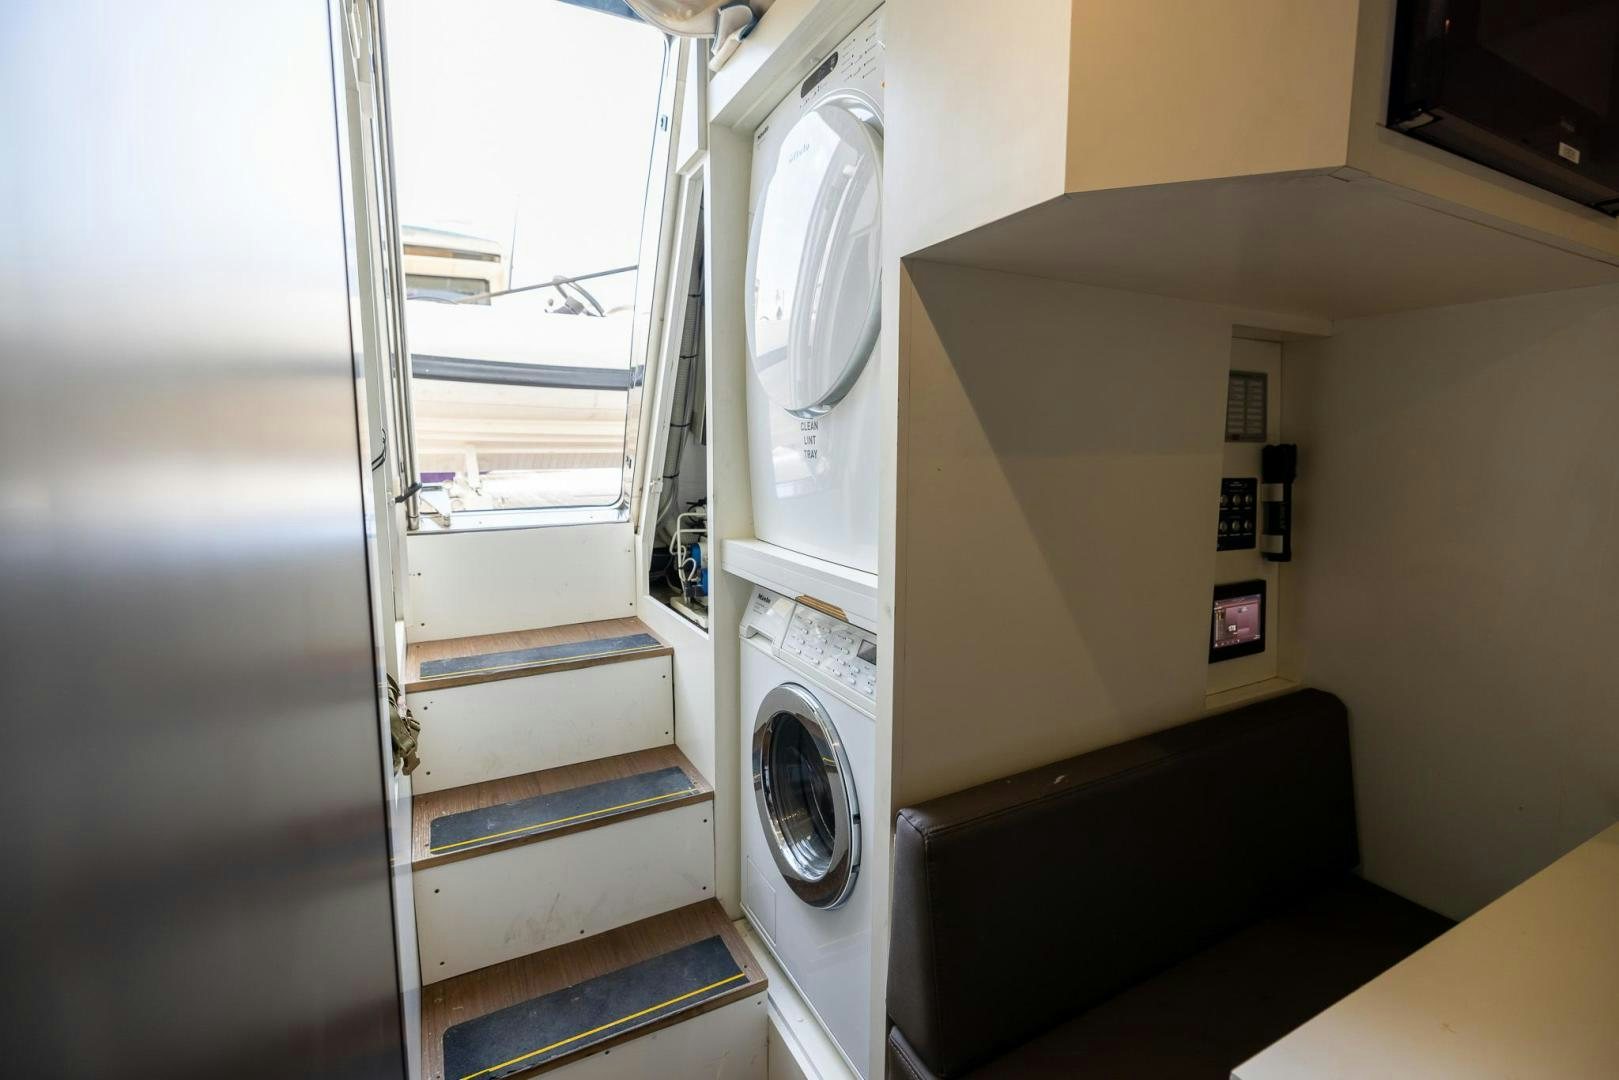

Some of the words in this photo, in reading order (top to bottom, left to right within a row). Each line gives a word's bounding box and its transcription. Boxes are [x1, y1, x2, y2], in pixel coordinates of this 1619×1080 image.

[800, 420, 819, 431] CLEAN
[803, 435, 817, 446] LINT
[803, 449, 818, 460] TRAY
